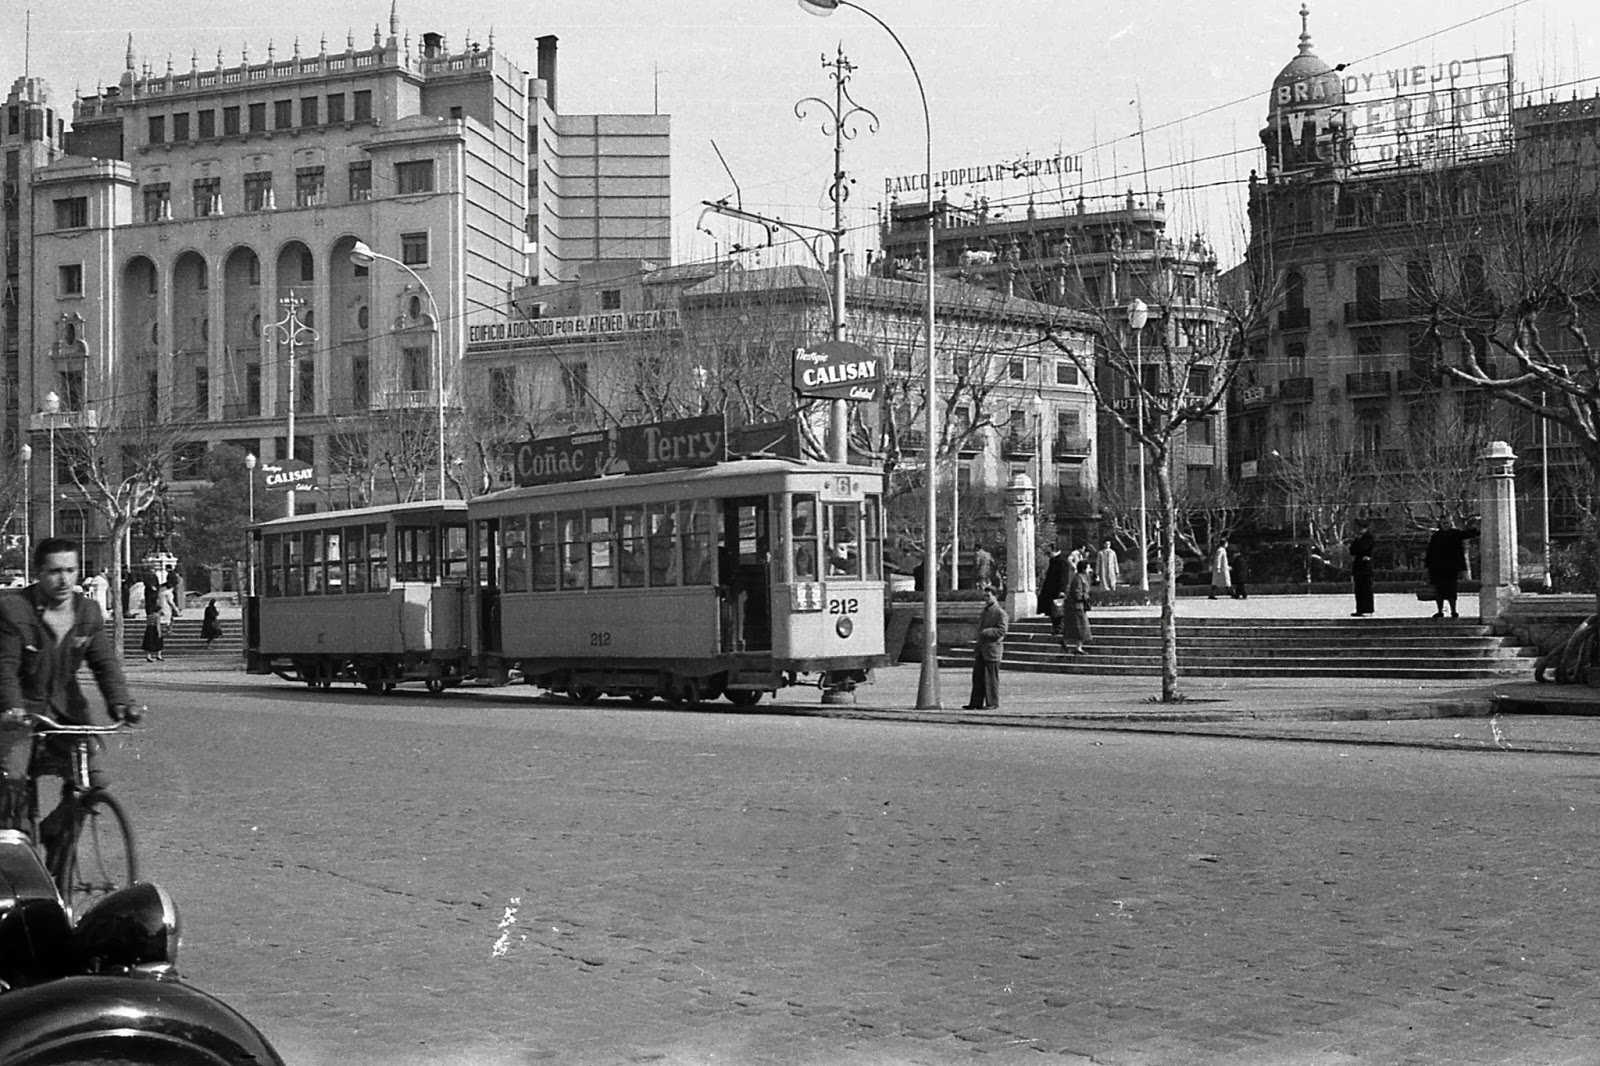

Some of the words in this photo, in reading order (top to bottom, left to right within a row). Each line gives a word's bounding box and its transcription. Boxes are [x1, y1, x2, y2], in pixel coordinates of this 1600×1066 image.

[1386, 59, 1462, 89] VIEJO
[884, 172, 929, 194] BANCO
[941, 163, 1004, 187] POPULAR
[1012, 153, 1083, 179] ESPAÑOL
[469, 323, 505, 342] EDIFICIO
[507, 319, 554, 339] ADQUIRIDO
[555, 321, 574, 334] POR
[575, 319, 587, 332] EL
[588, 315, 623, 333] ATENEO
[803, 359, 877, 386] CALISAY
[517, 444, 585, 478] Coñac
[643, 426, 722, 463] Terry
[265, 467, 314, 486] CALISAY
[829, 598, 859, 615] 212
[590, 631, 611, 647] 212
